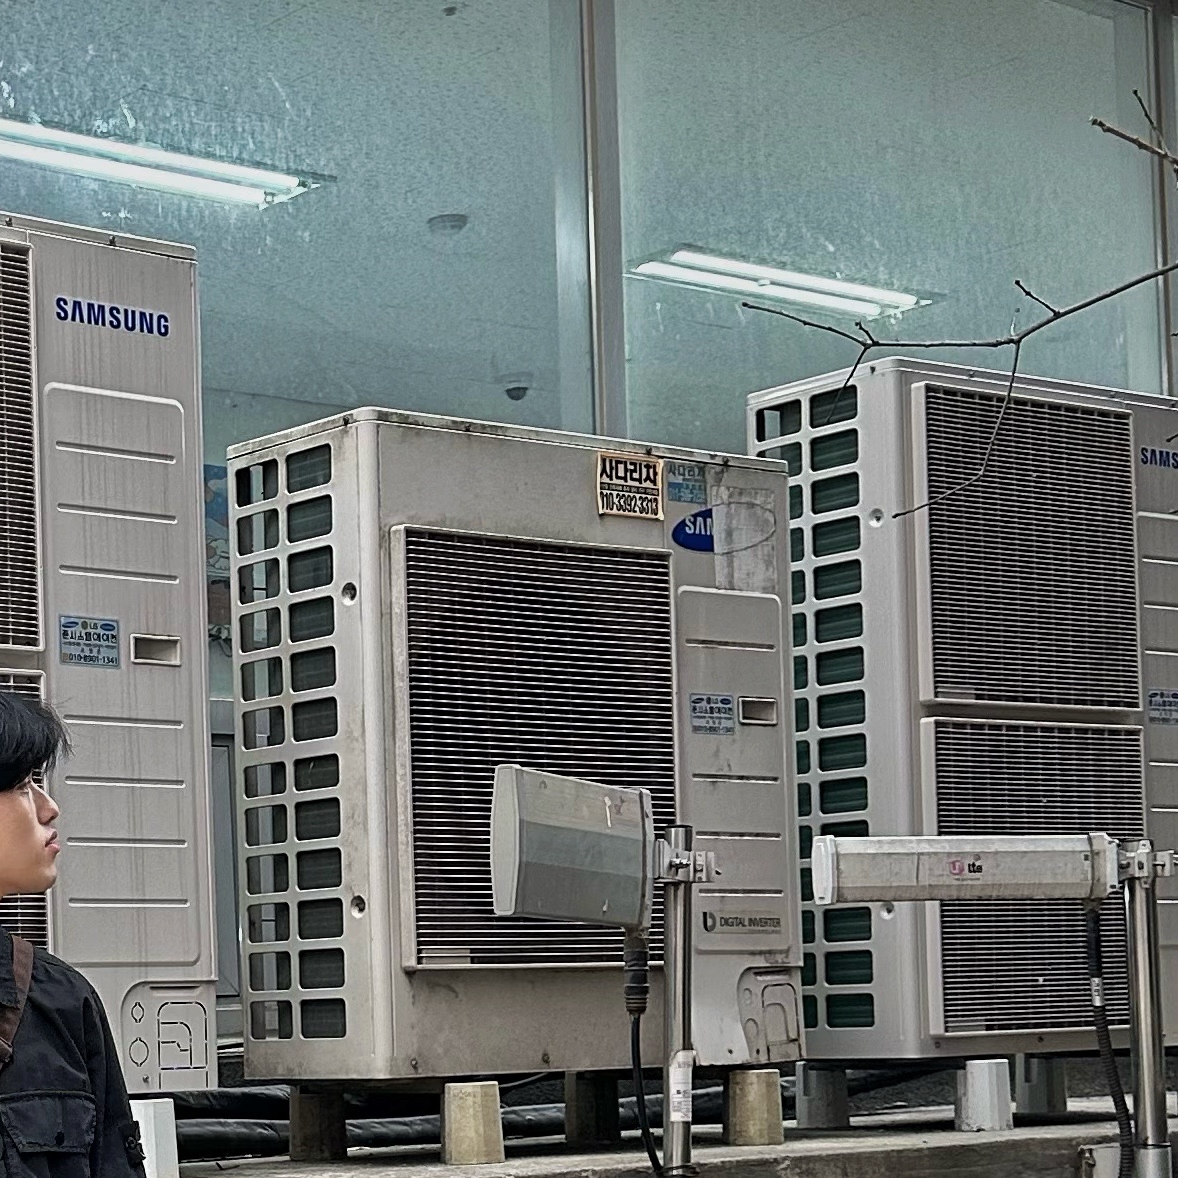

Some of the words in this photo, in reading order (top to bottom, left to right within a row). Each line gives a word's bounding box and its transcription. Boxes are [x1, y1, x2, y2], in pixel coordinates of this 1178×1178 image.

[55, 297, 169, 337] SAMSUNG
[600, 458, 658, 486] 사다리차
[719, 916, 747, 928] DIGITAL
